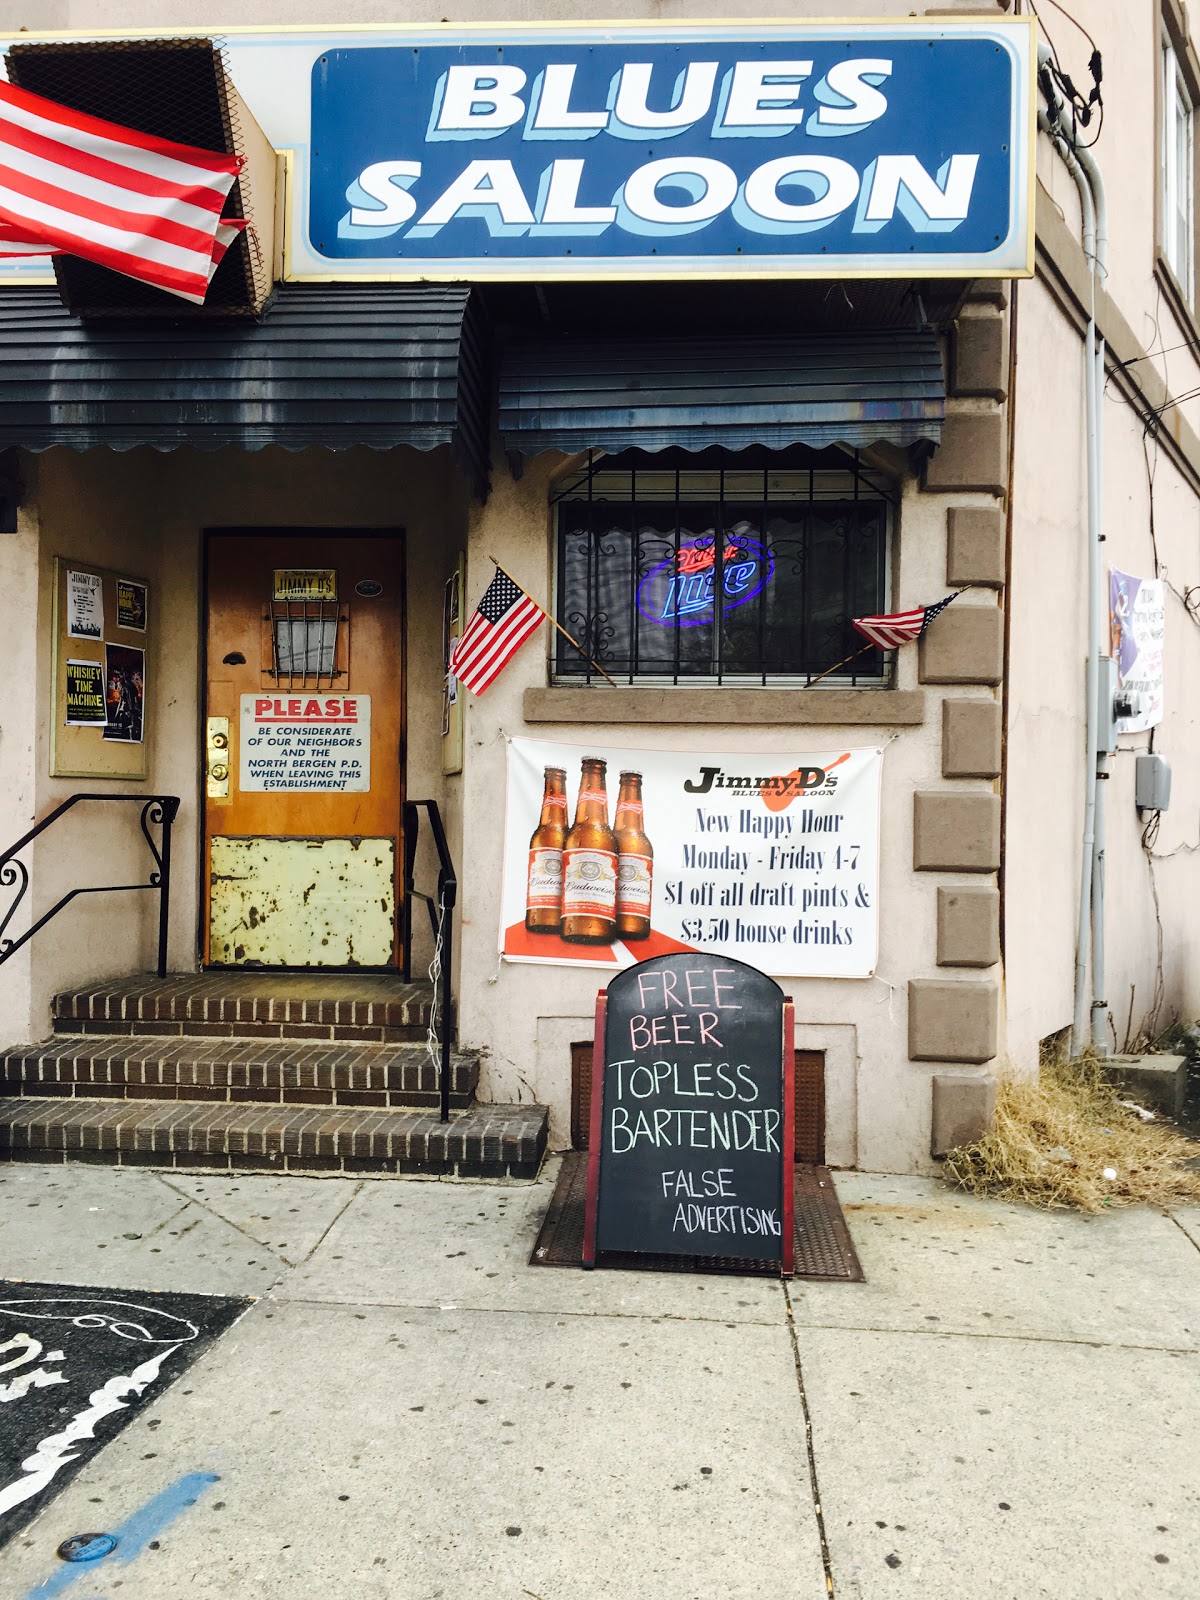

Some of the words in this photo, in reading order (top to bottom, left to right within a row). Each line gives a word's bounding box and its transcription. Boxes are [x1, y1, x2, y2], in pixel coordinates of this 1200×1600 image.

[425, 58, 893, 142] BLUES
[337, 153, 981, 239] SALOON
[72, 573, 91, 586] JIMMY
[278, 578, 313, 593] JIMMY
[661, 561, 757, 618] Lite
[67, 665, 101, 680] WHISKEY
[75, 680, 94, 693] TIME
[67, 693, 103, 707] MACHINE
[255, 699, 357, 717] PLEASE
[247, 738, 263, 746] OF
[267, 738, 292, 746] OUR
[296, 738, 362, 747] NEIGHBORS
[258, 727, 271, 736] BE
[276, 727, 352, 736] CONSIDERATE
[248, 759, 287, 768] NORTH
[292, 759, 336, 768] BERGEN
[341, 760, 363, 768] P.D.
[280, 749, 306, 757] AND
[310, 749, 331, 757] THE
[250, 770, 284, 778] WHEN
[288, 770, 334, 779] LEAVING
[338, 770, 361, 779] THIS
[263, 780, 348, 788] ESTABLISHMENT
[695, 808, 732, 833] New
[739, 809, 795, 839] Happy
[800, 809, 844, 834] Hour
[682, 844, 751, 875] Monday
[768, 845, 825, 874] Friday
[832, 845, 861, 870] 4-7
[565, 880, 616, 896] Budweiser
[664, 880, 683, 907] $1
[690, 881, 715, 906] off
[720, 882, 744, 906] all
[750, 881, 796, 906] draft
[802, 882, 848, 912] pints
[854, 882, 871, 908] &
[680, 918, 729, 943] $3.50
[735, 918, 786, 944] house
[793, 919, 853, 945] drinks
[638, 969, 742, 1010] FREE
[630, 1012, 724, 1051] BEER
[609, 1060, 759, 1102] TOPLESS
[612, 1107, 780, 1153] BARTENDER
[662, 1168, 737, 1198] FALSE
[673, 1202, 782, 1236] ADVERTISING
